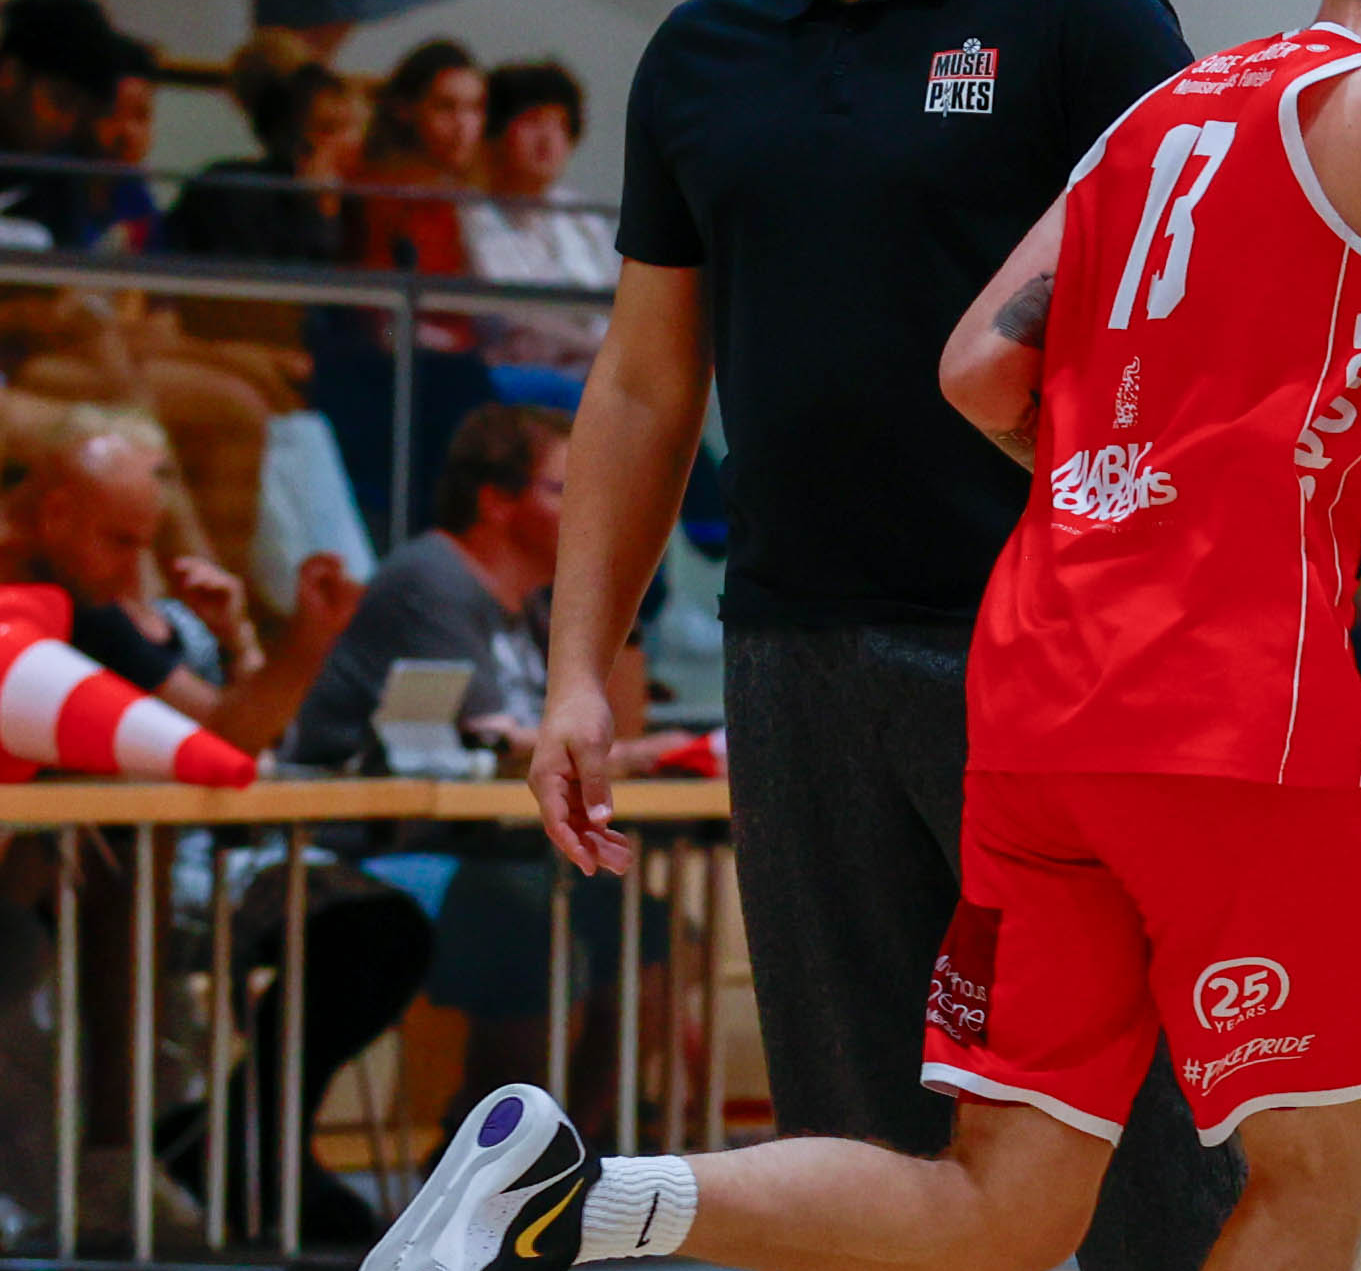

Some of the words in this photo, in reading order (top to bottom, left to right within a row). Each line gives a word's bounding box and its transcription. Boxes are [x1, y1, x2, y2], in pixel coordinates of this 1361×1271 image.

[933, 52, 993, 77] MUSEL
[1107, 120, 1237, 330] 13
[1208, 970, 1270, 1018] 25
[1214, 1003, 1267, 1034] YEARS
